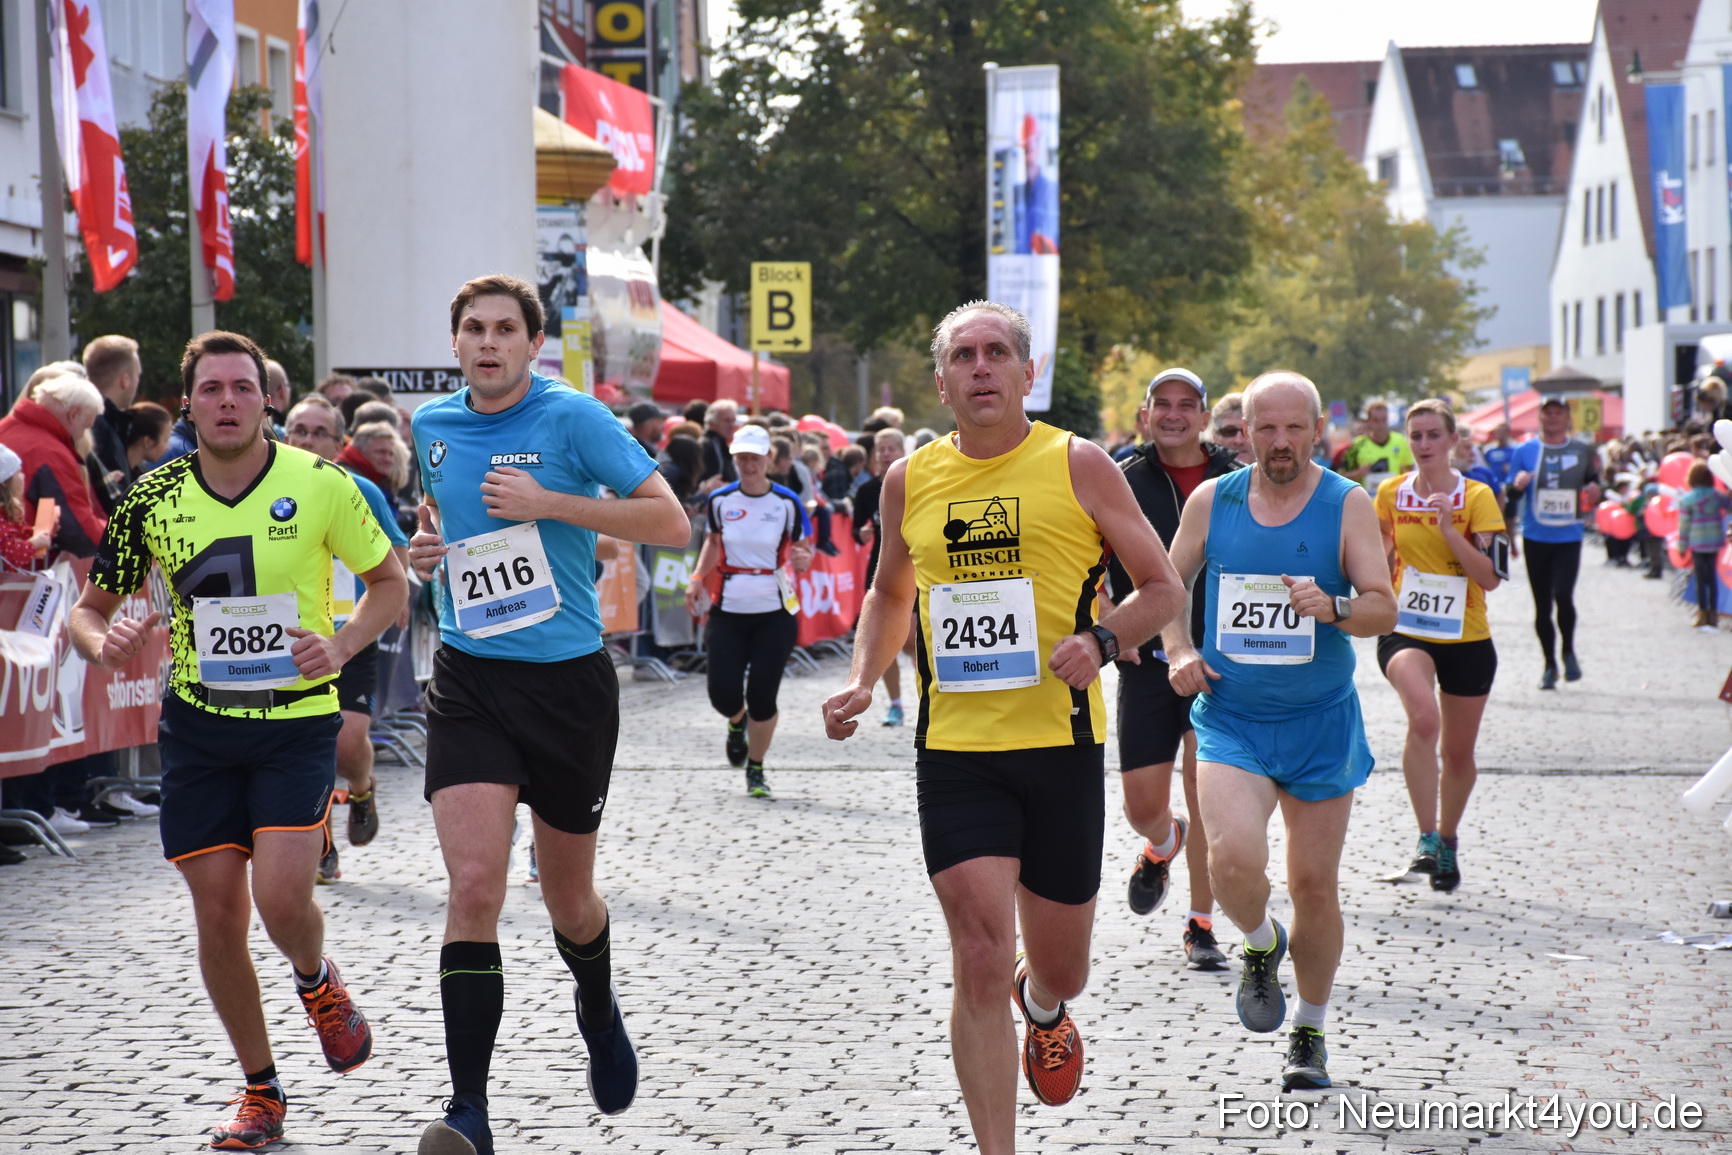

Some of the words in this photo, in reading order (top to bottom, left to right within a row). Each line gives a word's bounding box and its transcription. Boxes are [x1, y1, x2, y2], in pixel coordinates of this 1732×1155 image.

[758, 267, 803, 282] Block
[768, 290, 795, 330] B
[489, 453, 542, 465] BOCK
[268, 524, 298, 536] Partl
[475, 538, 509, 554] BOCK
[948, 549, 1021, 568] HIRSCH
[461, 556, 535, 600] 2116
[954, 568, 1023, 581] APOTHEKE
[1253, 583, 1287, 592] BOCK
[36, 582, 53, 615] swn
[961, 591, 1000, 602] BOCK
[1407, 591, 1455, 614] 2617
[231, 605, 267, 615] BOCK
[486, 600, 527, 619] Andreas
[1231, 602, 1301, 629] 2570
[1416, 617, 1440, 627] Marina
[210, 623, 284, 655] 2682
[943, 614, 1019, 649] 2434
[1244, 638, 1287, 649] Hermann
[228, 664, 271, 675] Dominik
[963, 660, 999, 672] Robert
